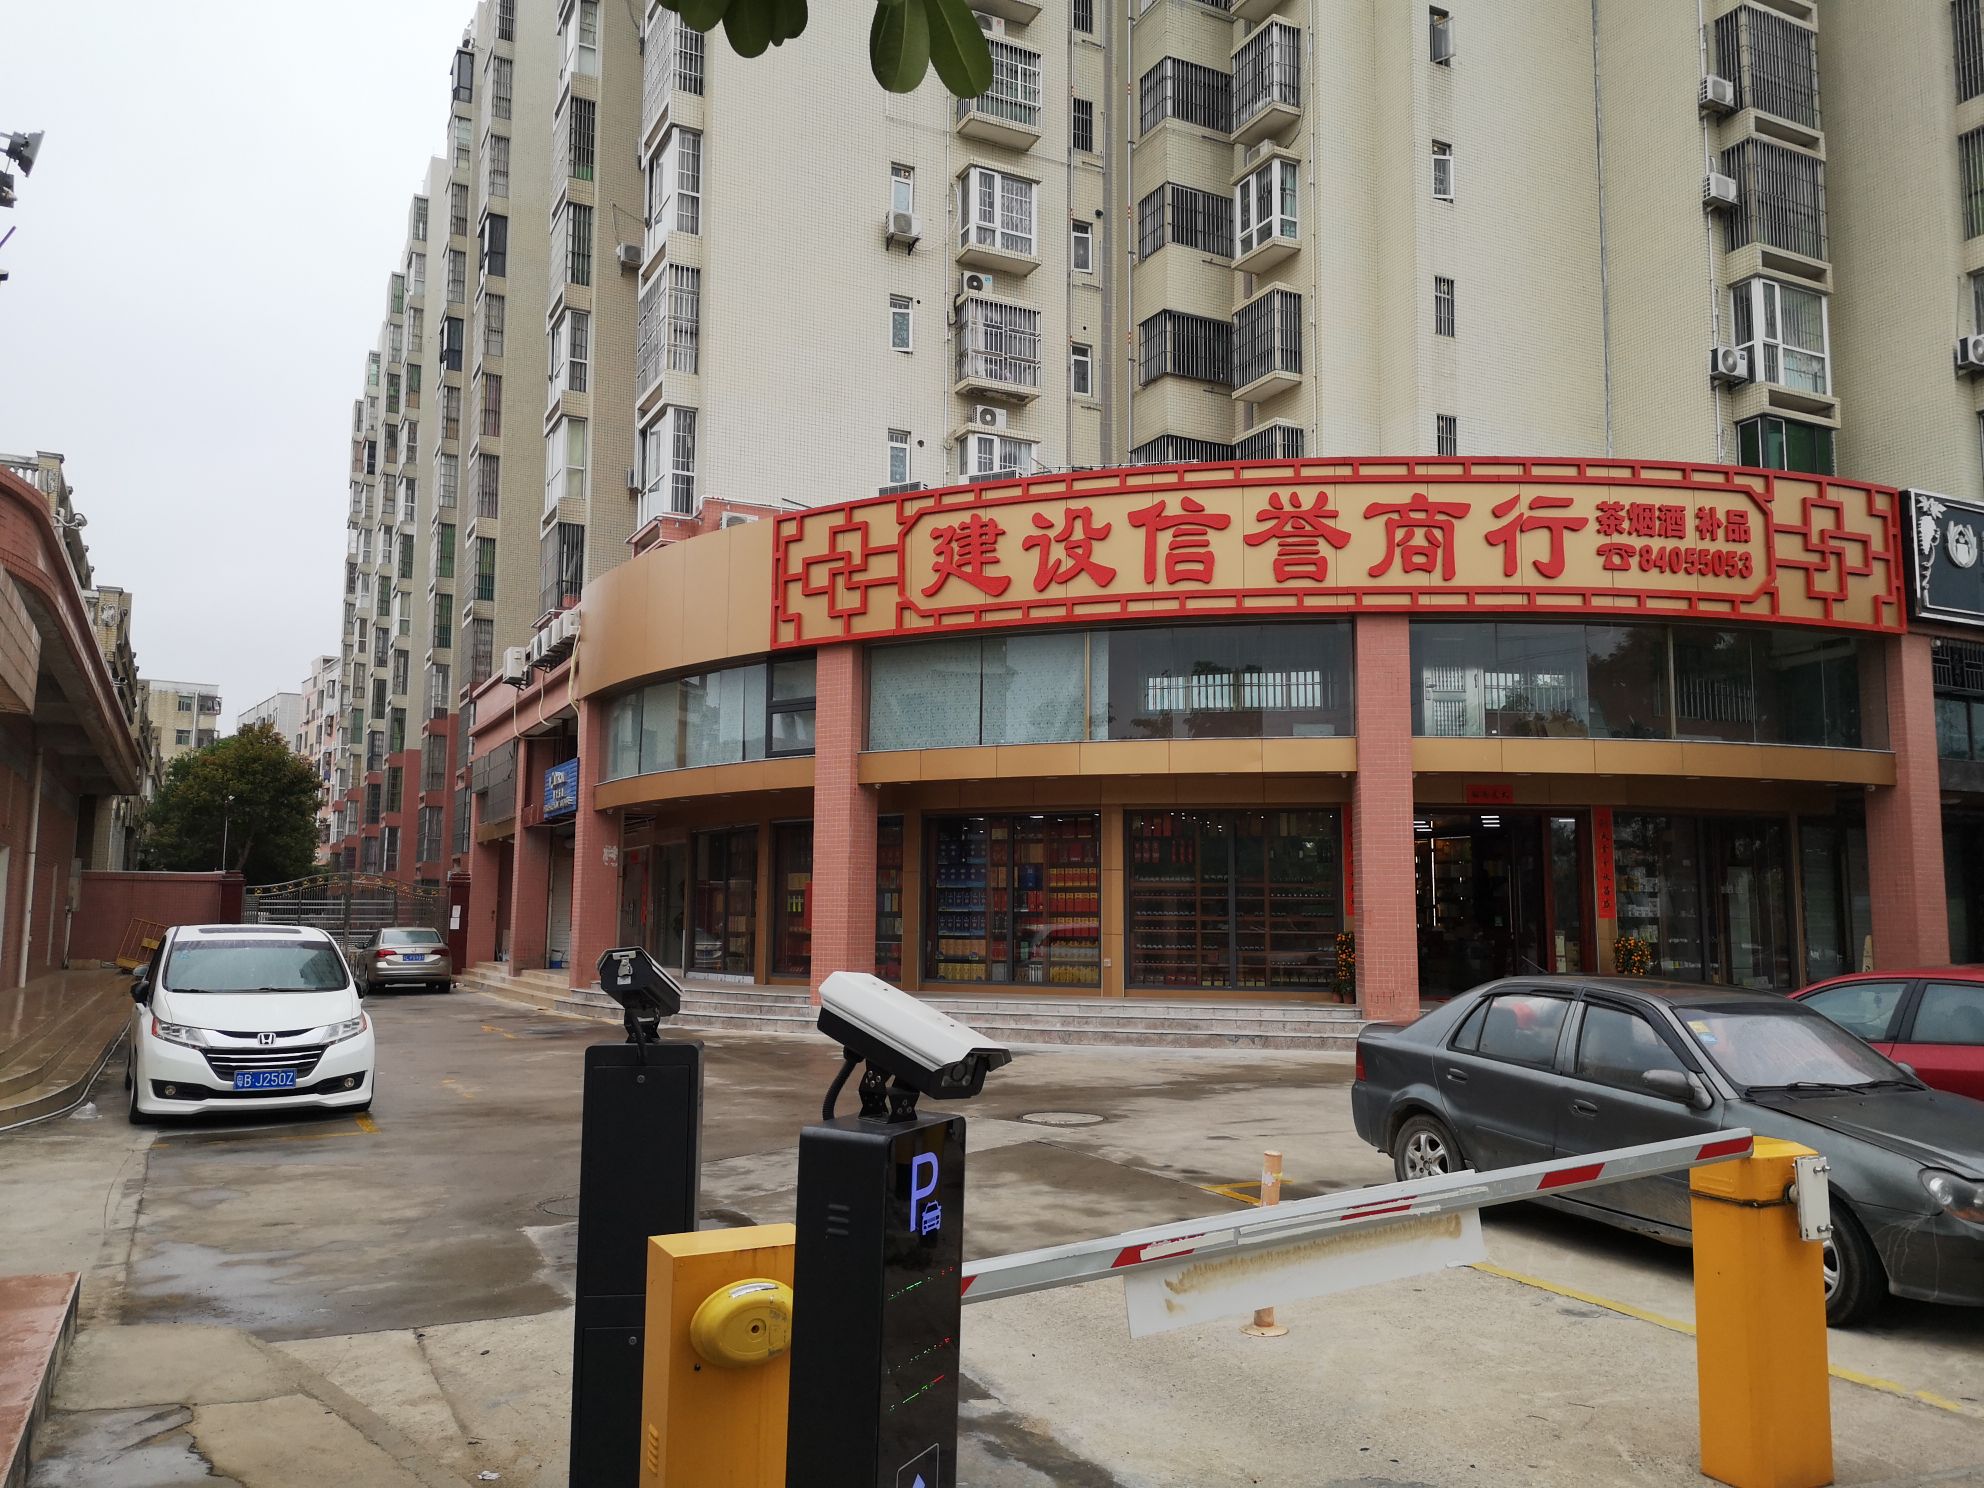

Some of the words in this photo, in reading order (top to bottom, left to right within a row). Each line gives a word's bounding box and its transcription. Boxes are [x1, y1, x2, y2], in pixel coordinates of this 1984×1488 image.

[921, 491, 1589, 597] 建设信誉商行
[1596, 501, 1686, 539] 茶烟酒
[1696, 506, 1751, 543] 补品
[1639, 544, 1753, 579] 84055053
[910, 1151, 939, 1232] P
